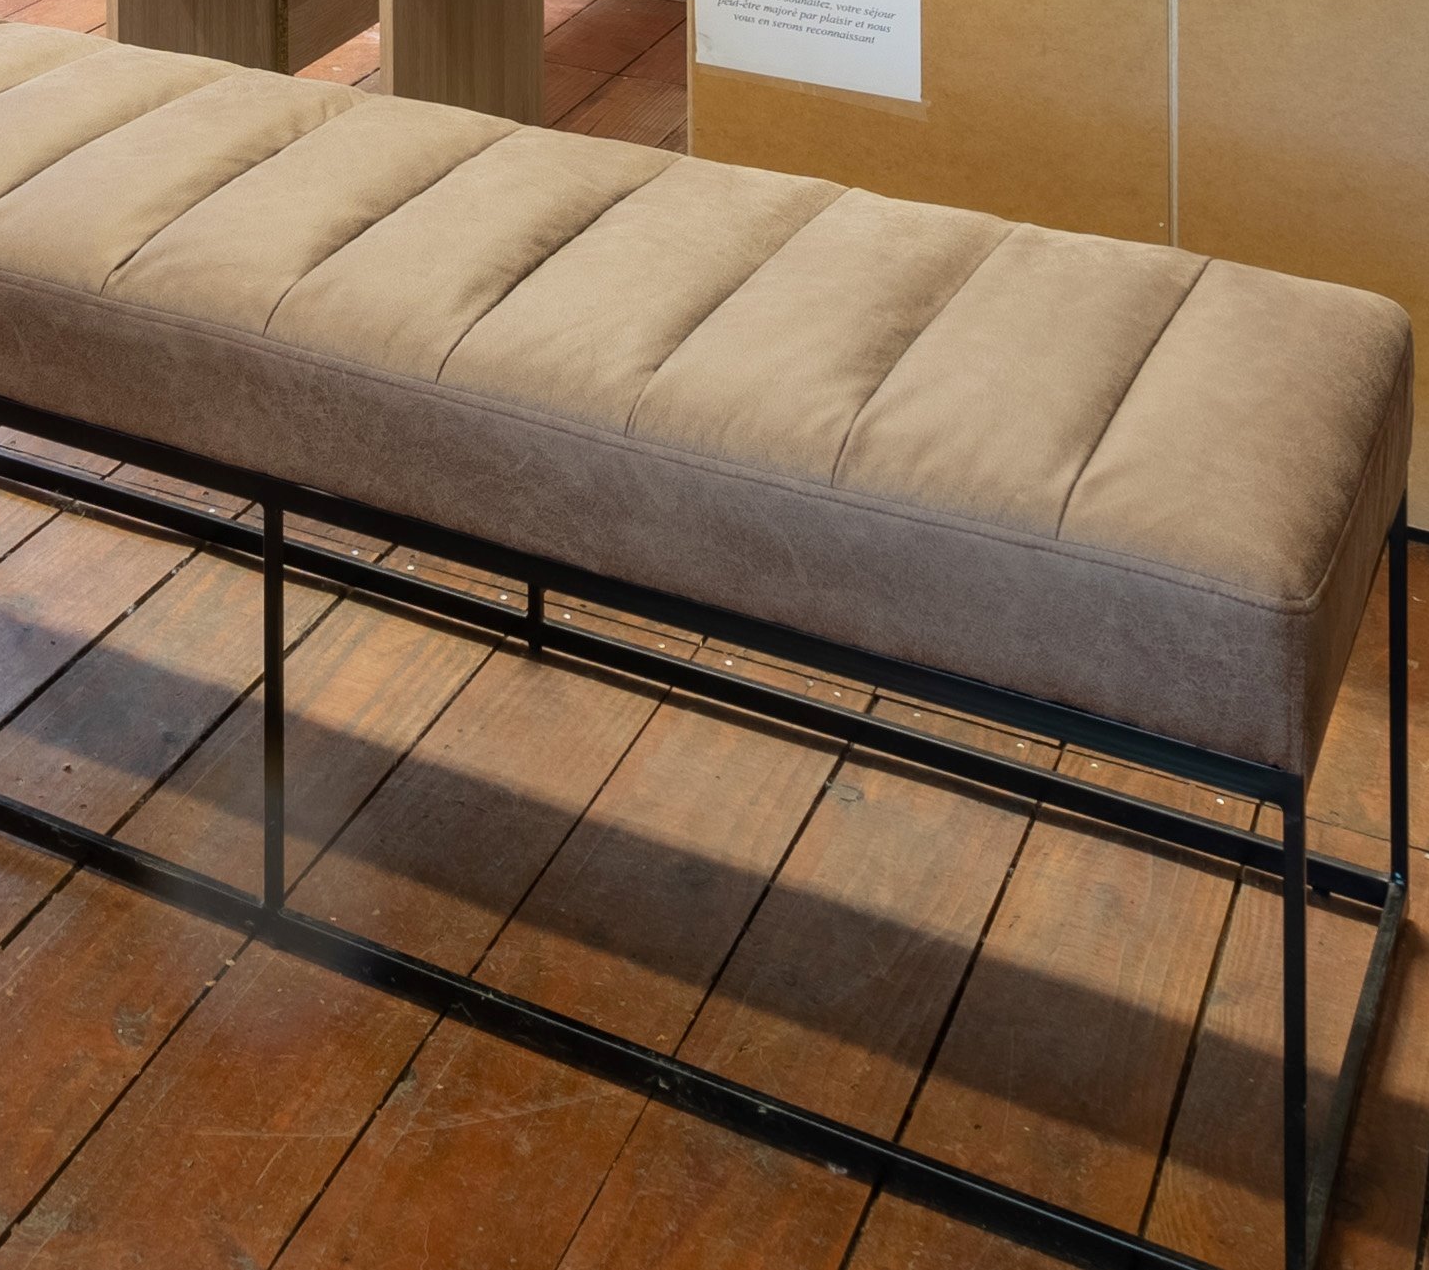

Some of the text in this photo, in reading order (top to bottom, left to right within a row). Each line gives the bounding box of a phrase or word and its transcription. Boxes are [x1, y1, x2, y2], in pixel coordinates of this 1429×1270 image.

[763, 4, 799, 20] majoré
[799, 11, 818, 23] par
[819, 12, 853, 27] plaisir
[855, 18, 865, 29] et
[867, 22, 893, 34] nous
[836, 2, 862, 15] votre
[863, 6, 897, 21] séjour
[733, 12, 877, 46] vous en serons reconnaissant
